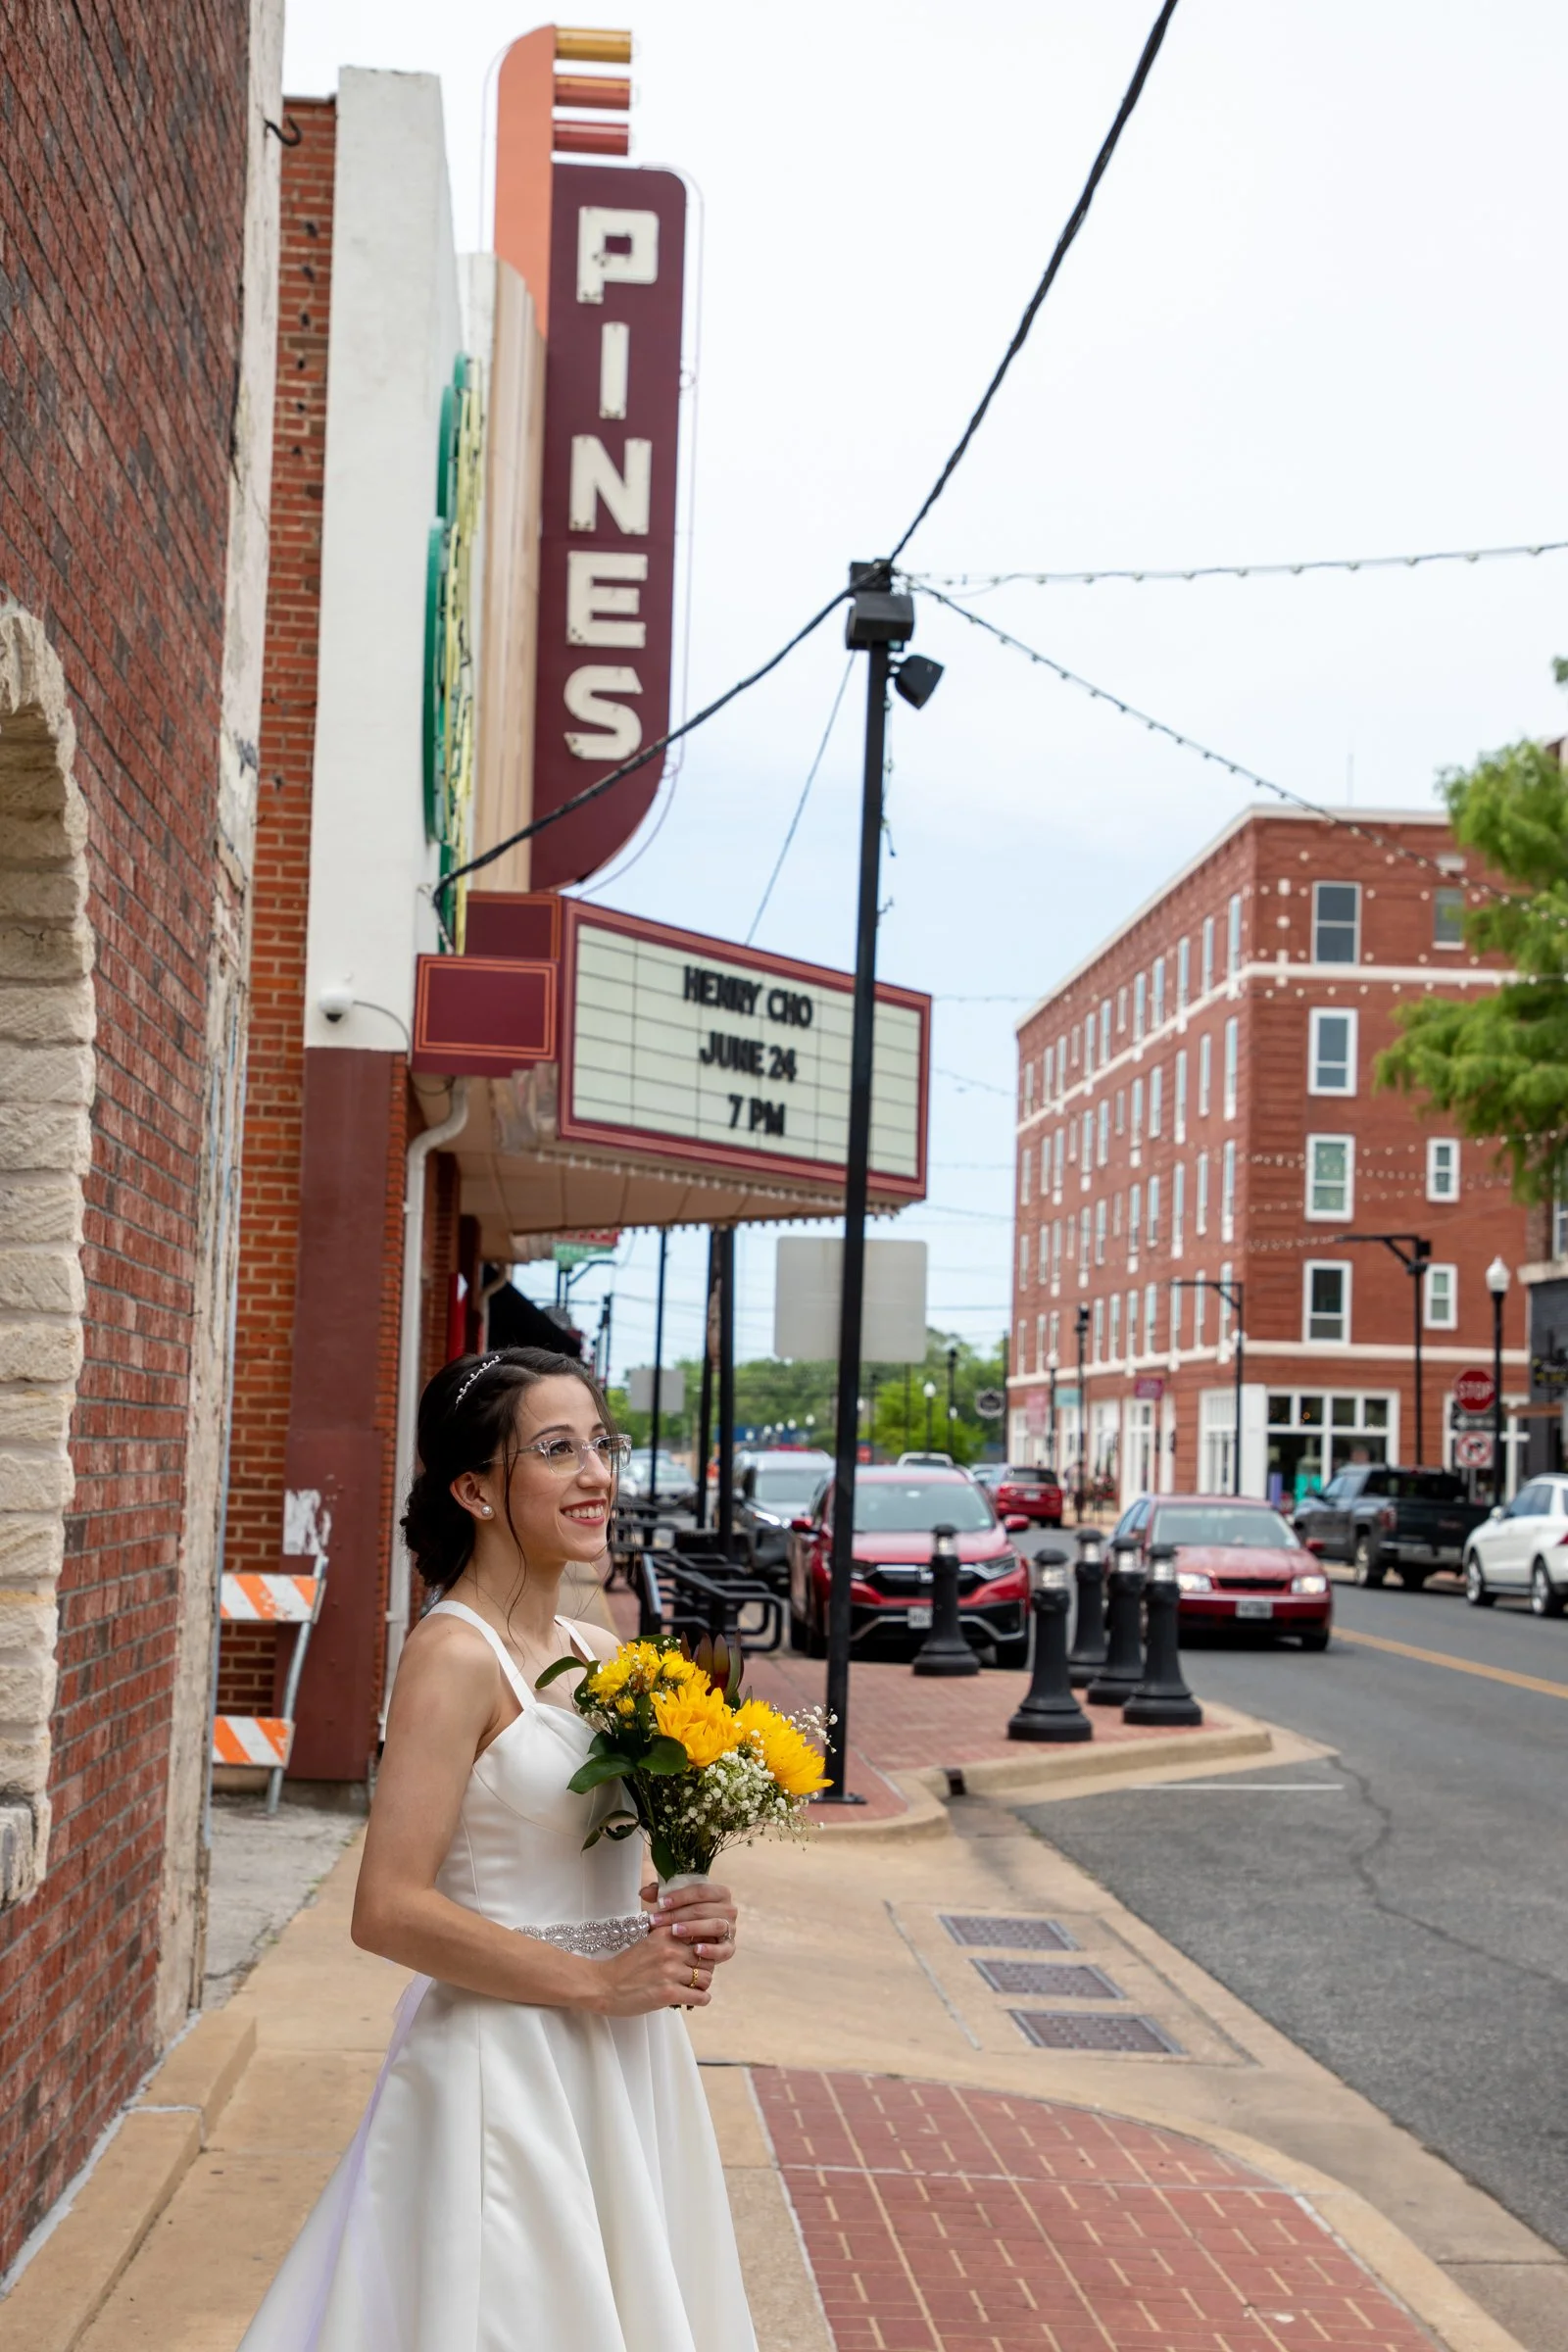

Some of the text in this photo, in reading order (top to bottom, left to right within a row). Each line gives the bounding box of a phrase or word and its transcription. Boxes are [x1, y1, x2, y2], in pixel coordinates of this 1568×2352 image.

[564, 206, 660, 760] PINES
[684, 964, 812, 1028] HENRY CHO
[700, 1032, 797, 1083] JUNE 24
[728, 1094, 785, 1137] 7 PM
[1457, 1380, 1494, 1399] STOP
